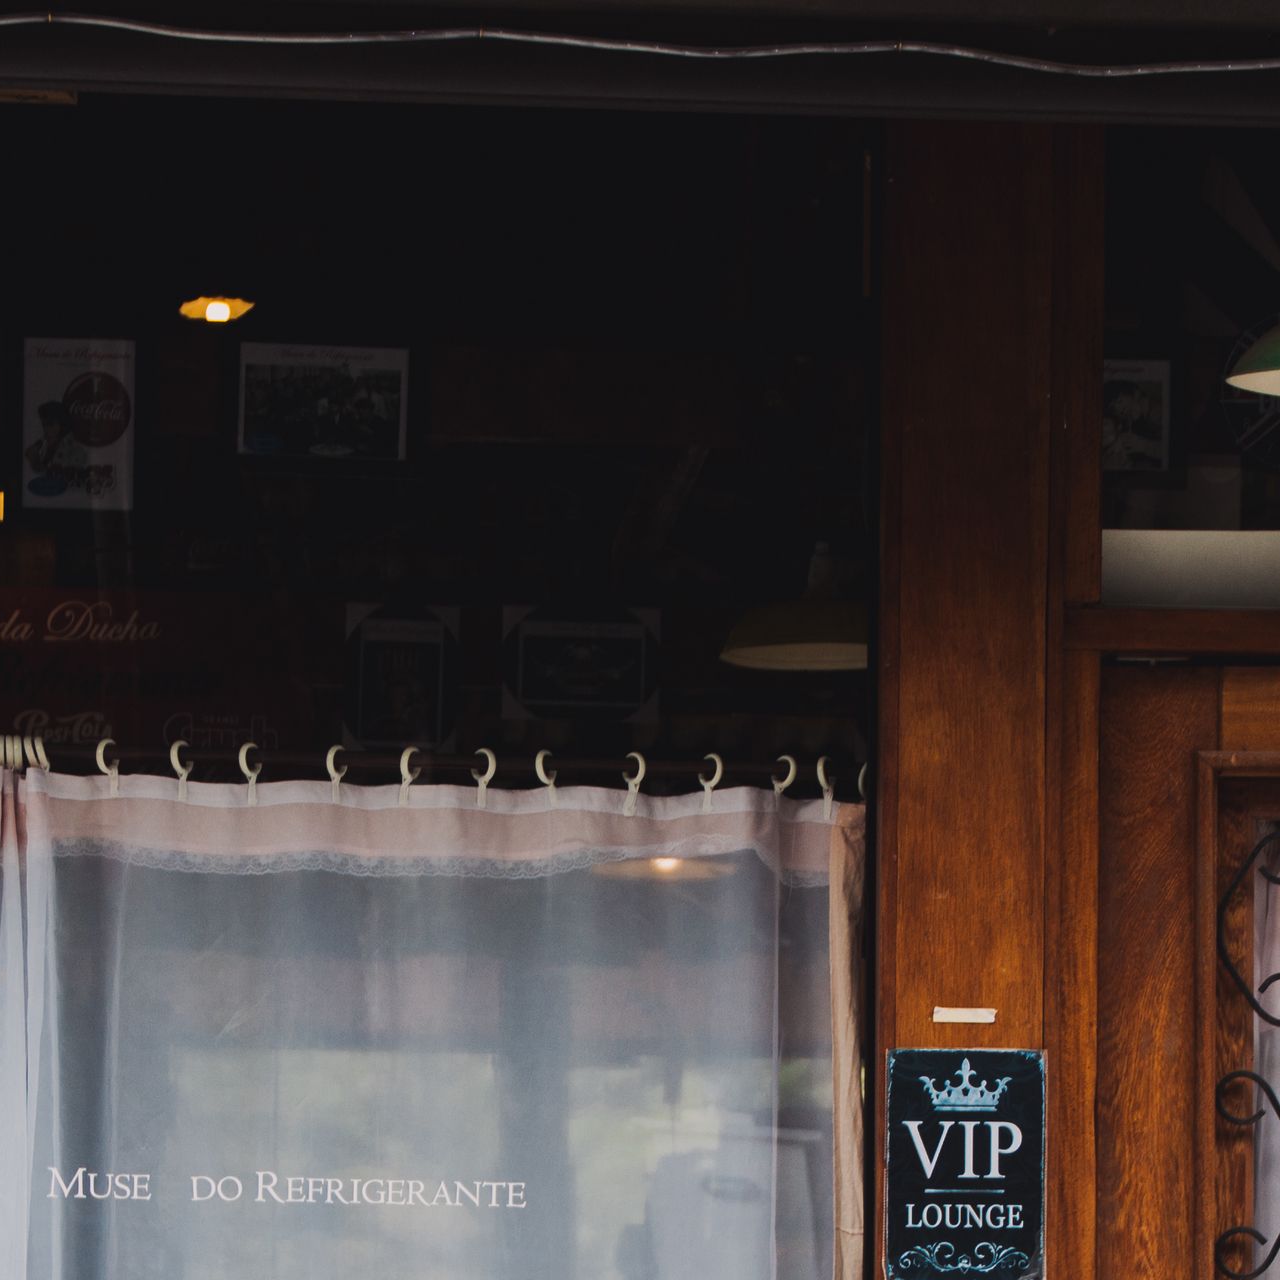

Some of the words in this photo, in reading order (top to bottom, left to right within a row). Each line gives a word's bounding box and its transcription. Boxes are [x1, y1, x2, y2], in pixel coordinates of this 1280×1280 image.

[43, 599, 161, 641] Ducha
[902, 1120, 1023, 1179] VIP
[905, 1203, 1024, 1229] LOUNGE
